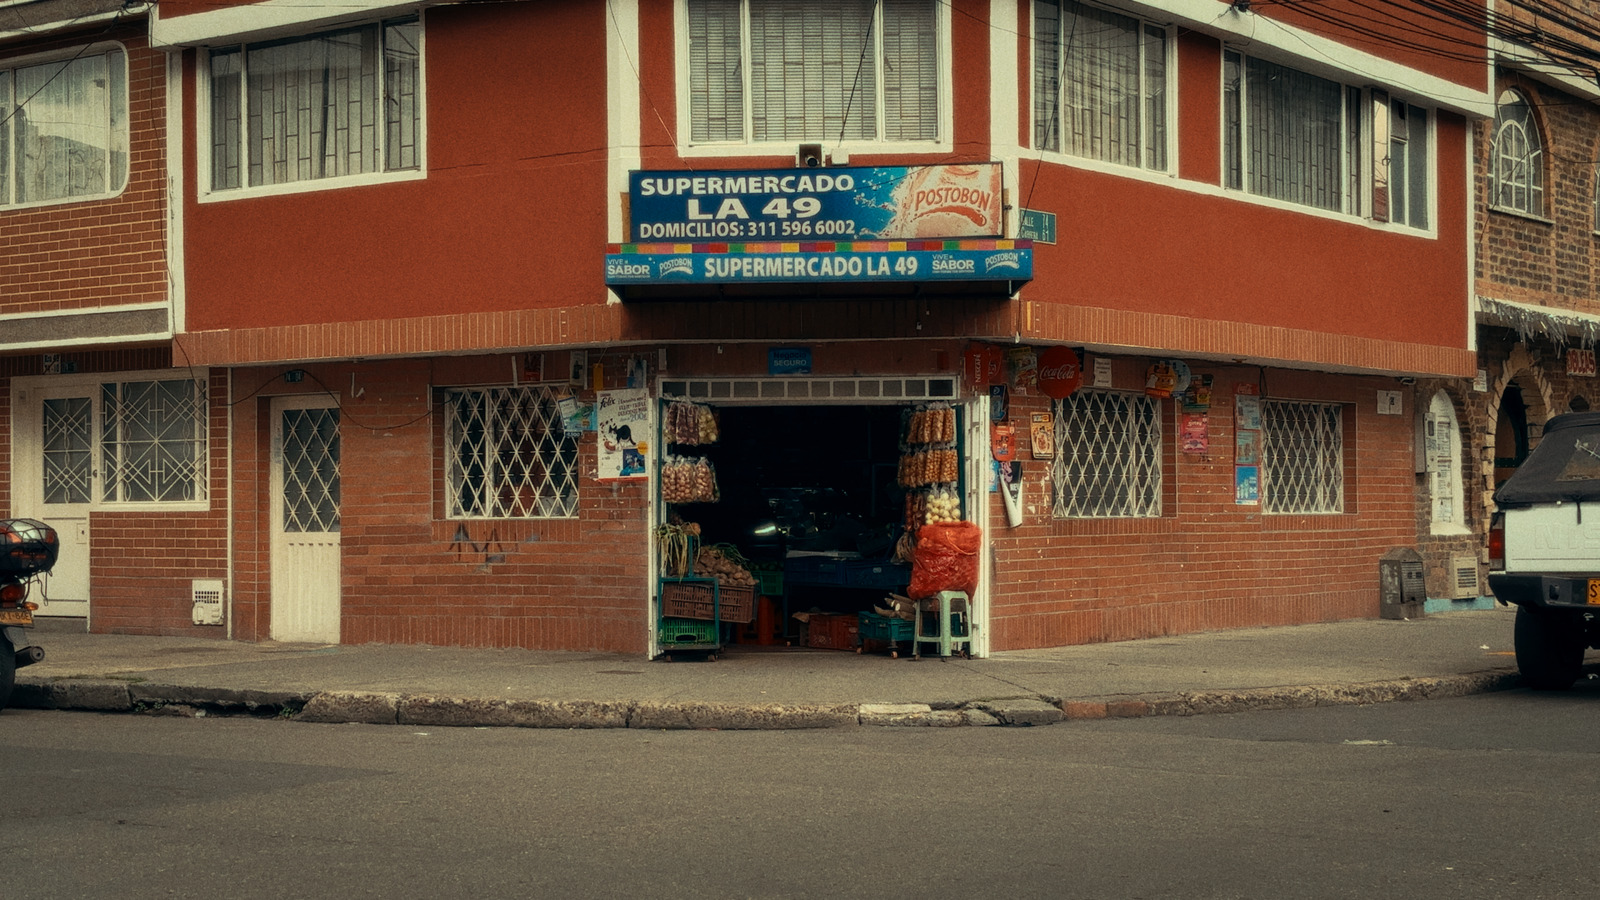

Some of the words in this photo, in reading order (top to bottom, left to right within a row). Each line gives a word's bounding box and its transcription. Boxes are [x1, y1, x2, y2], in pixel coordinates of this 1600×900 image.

[640, 173, 854, 196] SUPERMERCADO
[687, 198, 750, 220] LA
[761, 197, 823, 219] 49
[914, 187, 992, 213] POSTOBON
[639, 221, 745, 239] DOMICILIOS:
[747, 220, 779, 237] 311
[781, 220, 813, 236] 596
[815, 219, 855, 236] 6002
[659, 258, 693, 271] POSTOBON
[705, 257, 864, 278] SUPERMERCADO
[866, 256, 891, 277] LA
[894, 255, 918, 277] 49
[931, 260, 975, 270] SABOR
[985, 253, 1019, 267] POSTOBON
[607, 265, 650, 275] SABOR
[773, 359, 807, 367] SEGURO
[973, 353, 981, 383] NESCAFÉ
[1039, 363, 1077, 380] Coca-Cola
